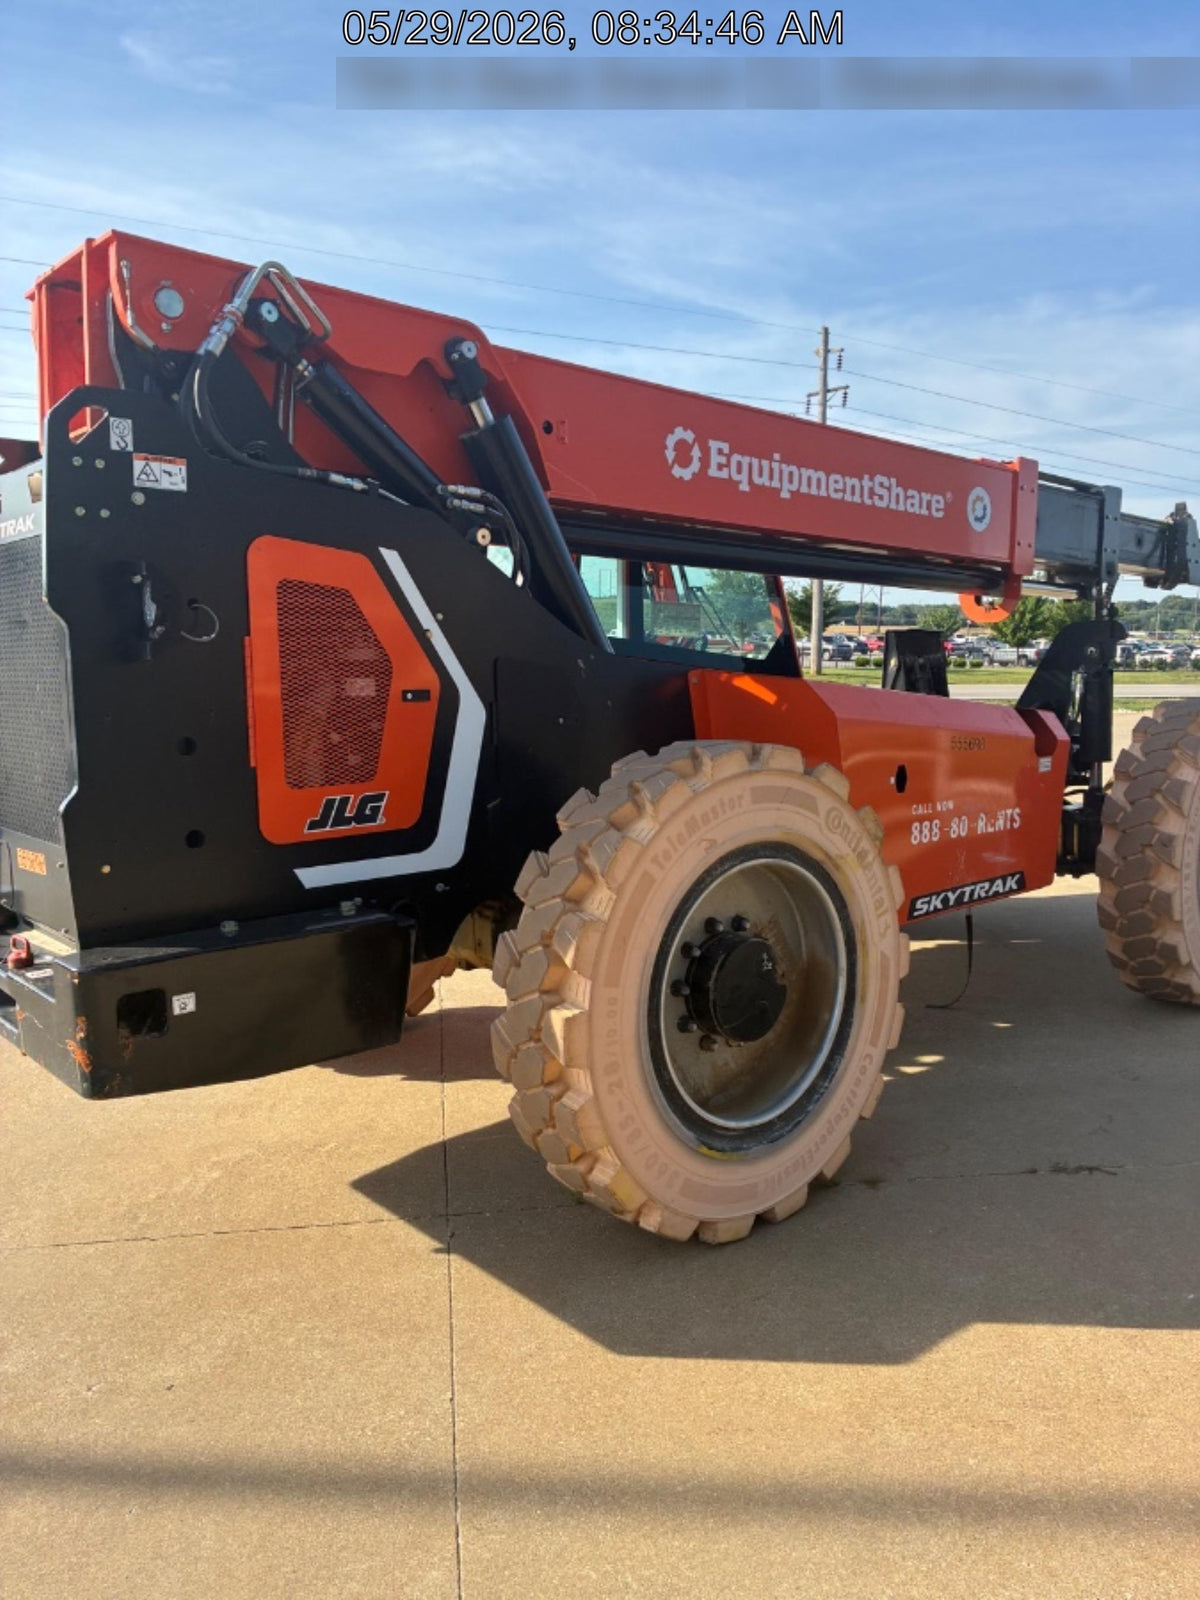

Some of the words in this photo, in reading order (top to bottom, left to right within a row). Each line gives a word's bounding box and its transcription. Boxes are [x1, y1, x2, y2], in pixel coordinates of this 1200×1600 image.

[304, 791, 389, 833] JLG
[911, 804, 933, 815] CALL
[913, 874, 1020, 917] SKYTRAK
